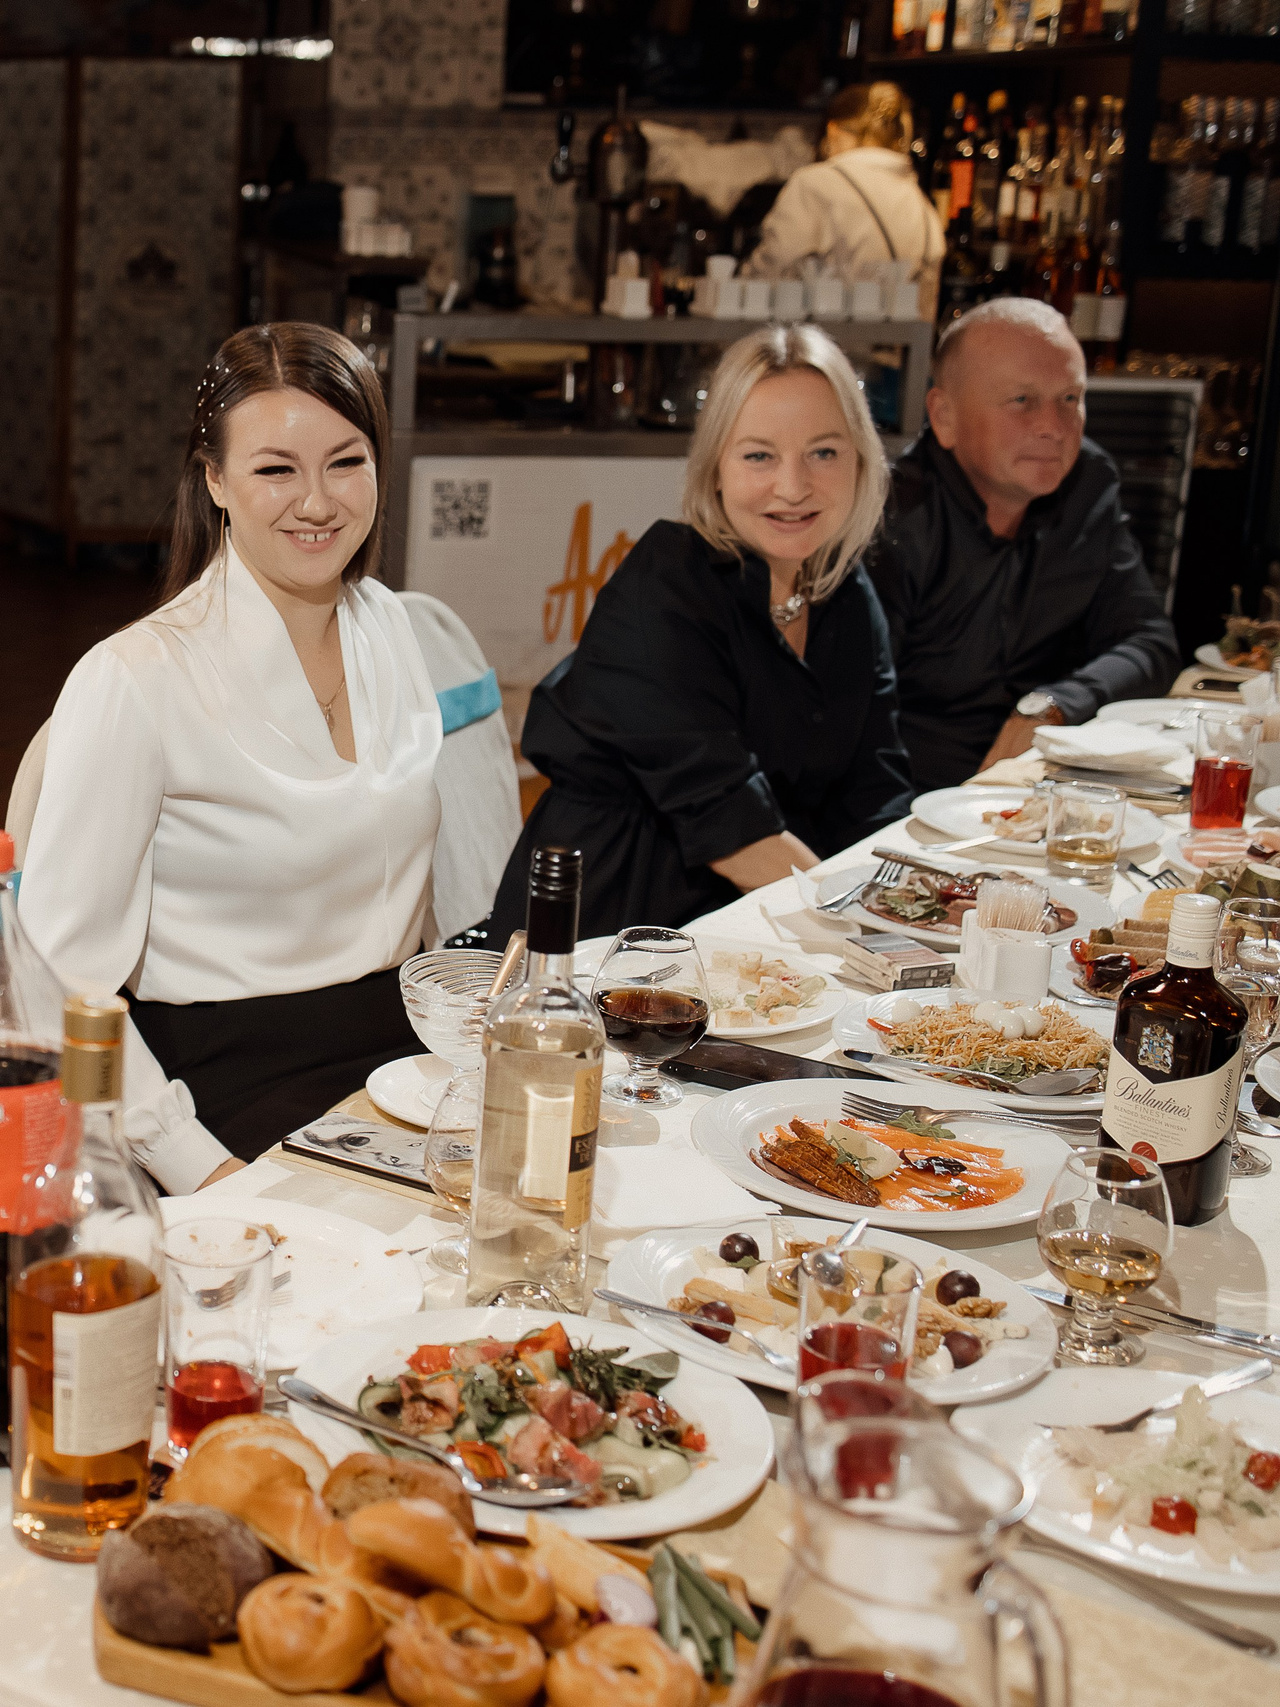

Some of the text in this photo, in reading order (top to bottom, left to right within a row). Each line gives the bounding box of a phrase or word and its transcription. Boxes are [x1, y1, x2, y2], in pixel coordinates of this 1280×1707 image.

[1114, 1077, 1192, 1118] Ballantine's
[1134, 1104, 1165, 1119] FINEST
[1215, 1068, 1234, 1130] Ballantine's
[1114, 1105, 1138, 1118] BLENDED
[1140, 1112, 1163, 1126] SCOTCH
[1164, 1121, 1187, 1133] WHISKY
